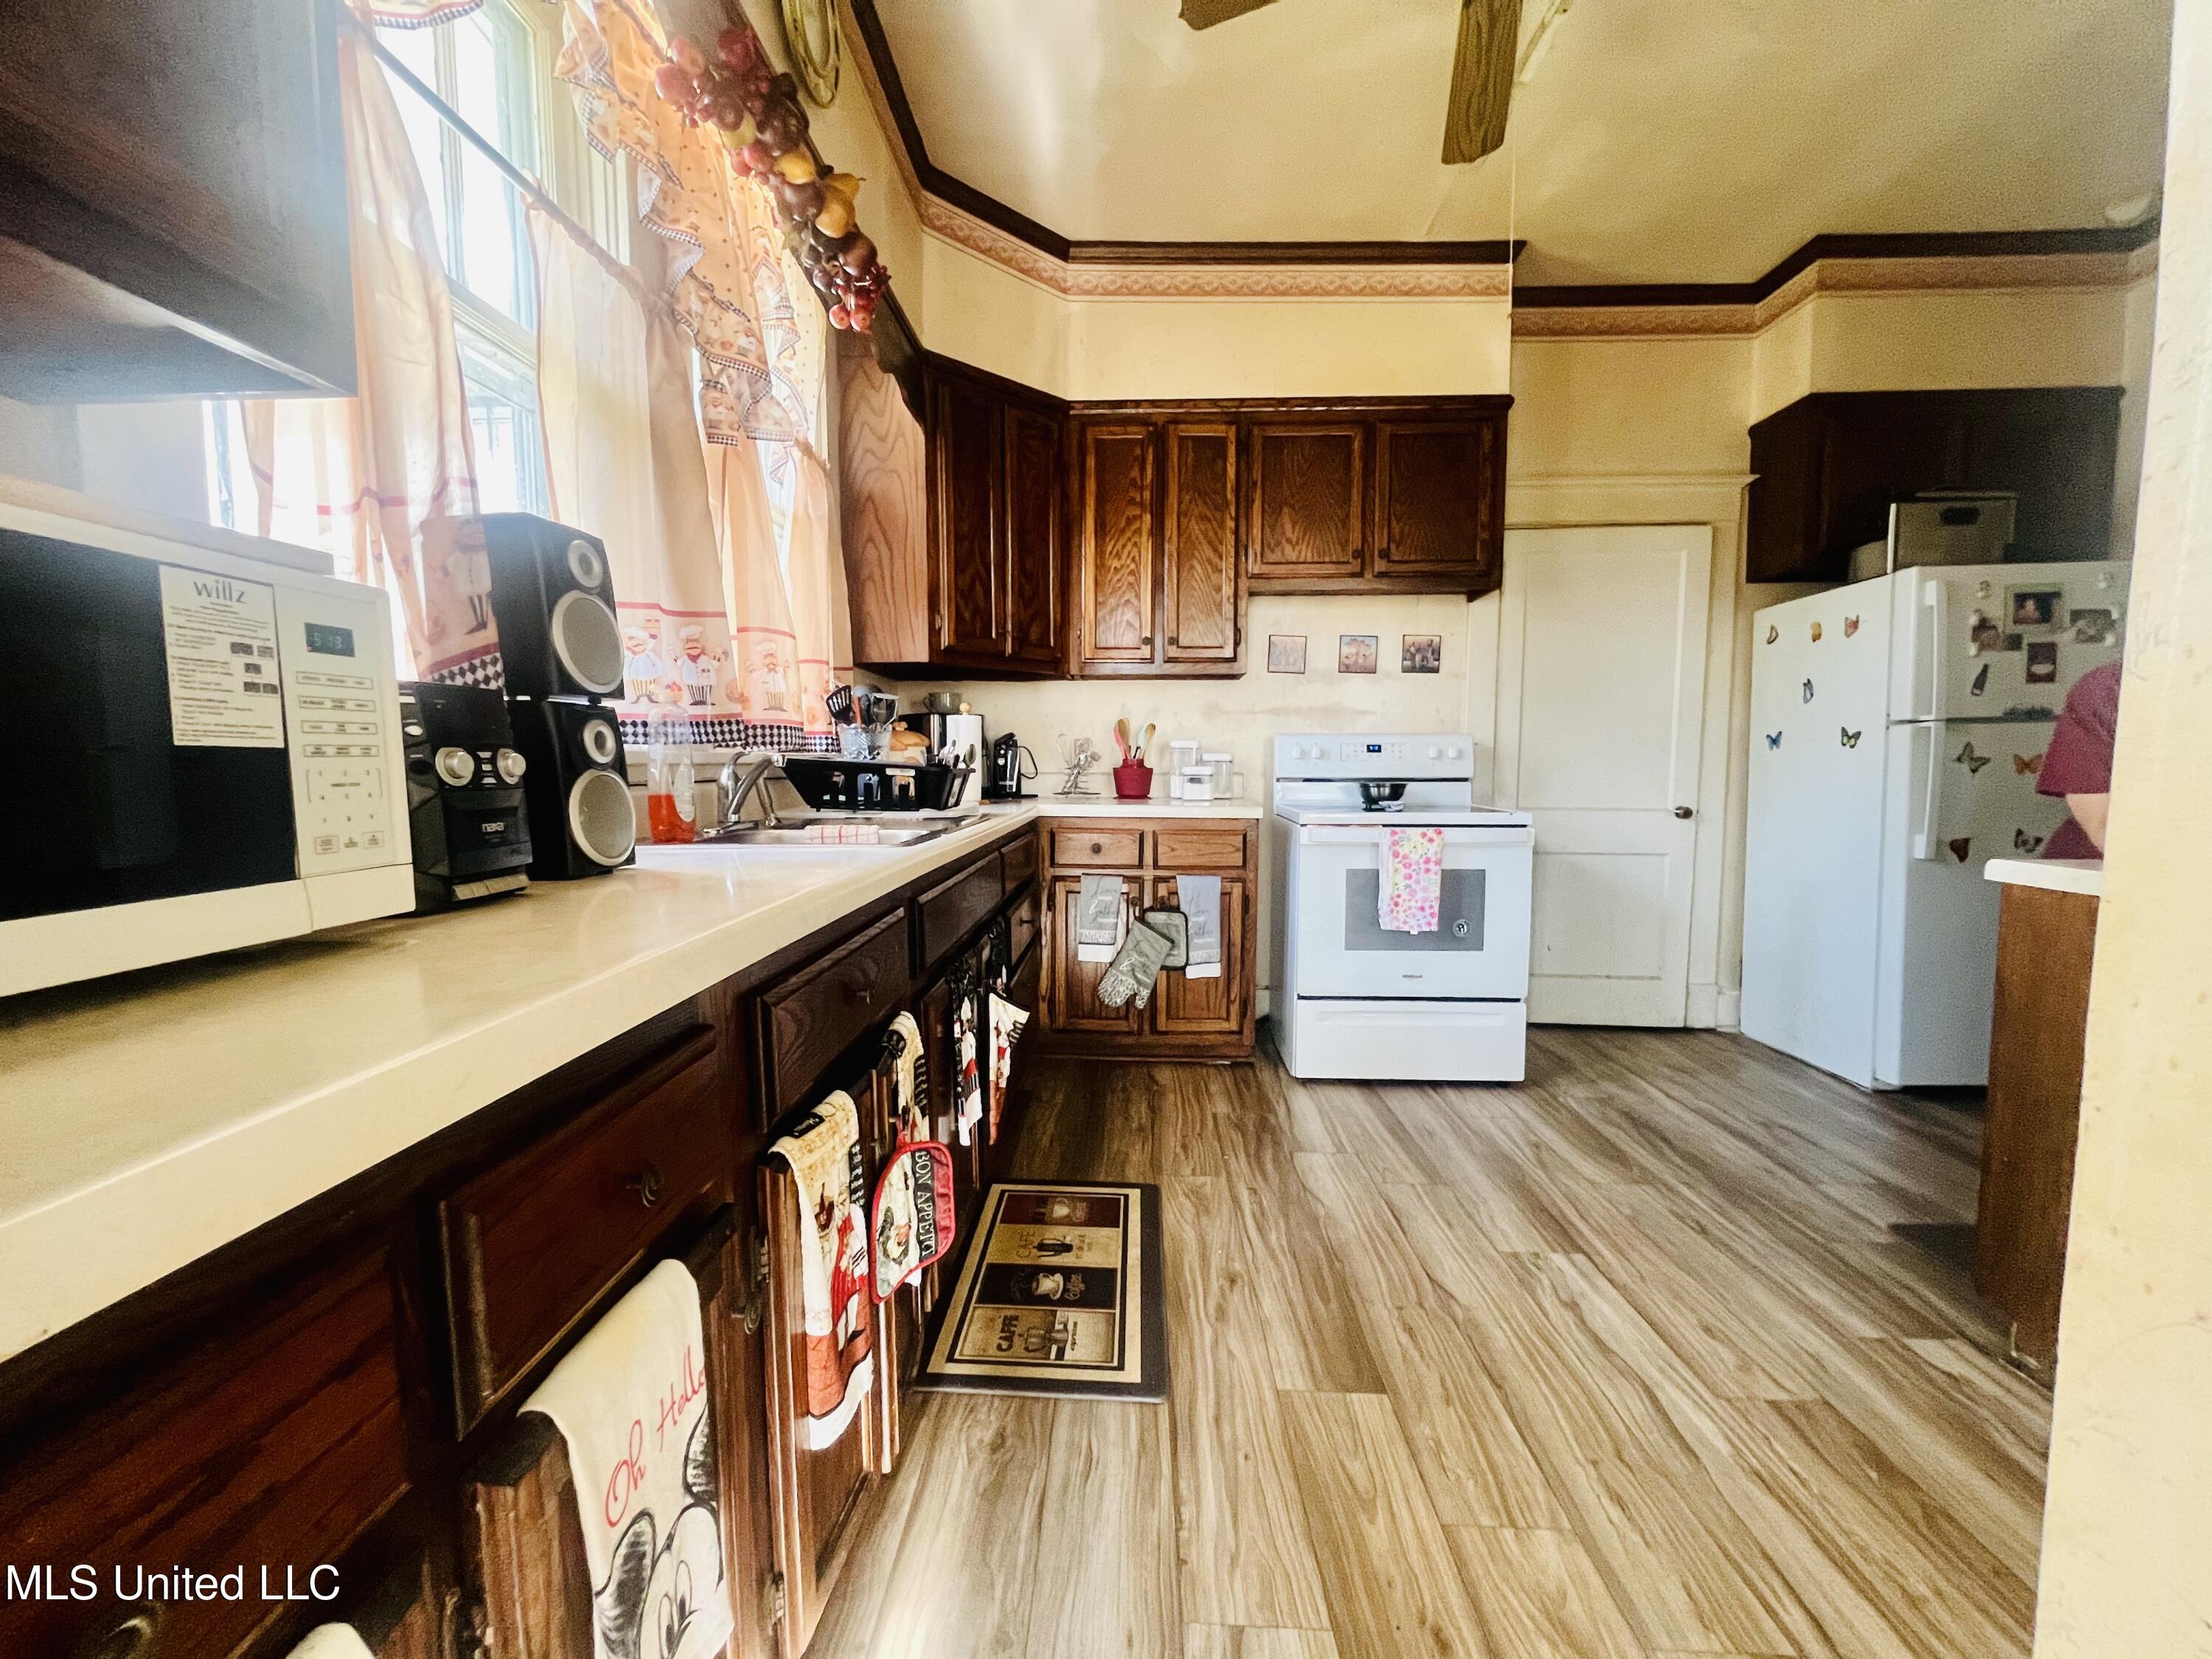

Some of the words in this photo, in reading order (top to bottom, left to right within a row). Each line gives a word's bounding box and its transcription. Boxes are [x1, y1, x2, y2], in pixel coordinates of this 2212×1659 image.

[193, 580, 248, 605] willz
[915, 1150, 932, 1185] BON
[917, 1191, 936, 1257] APPETIT
[605, 1419, 646, 1528] Oh
[656, 1344, 706, 1453] Hello
